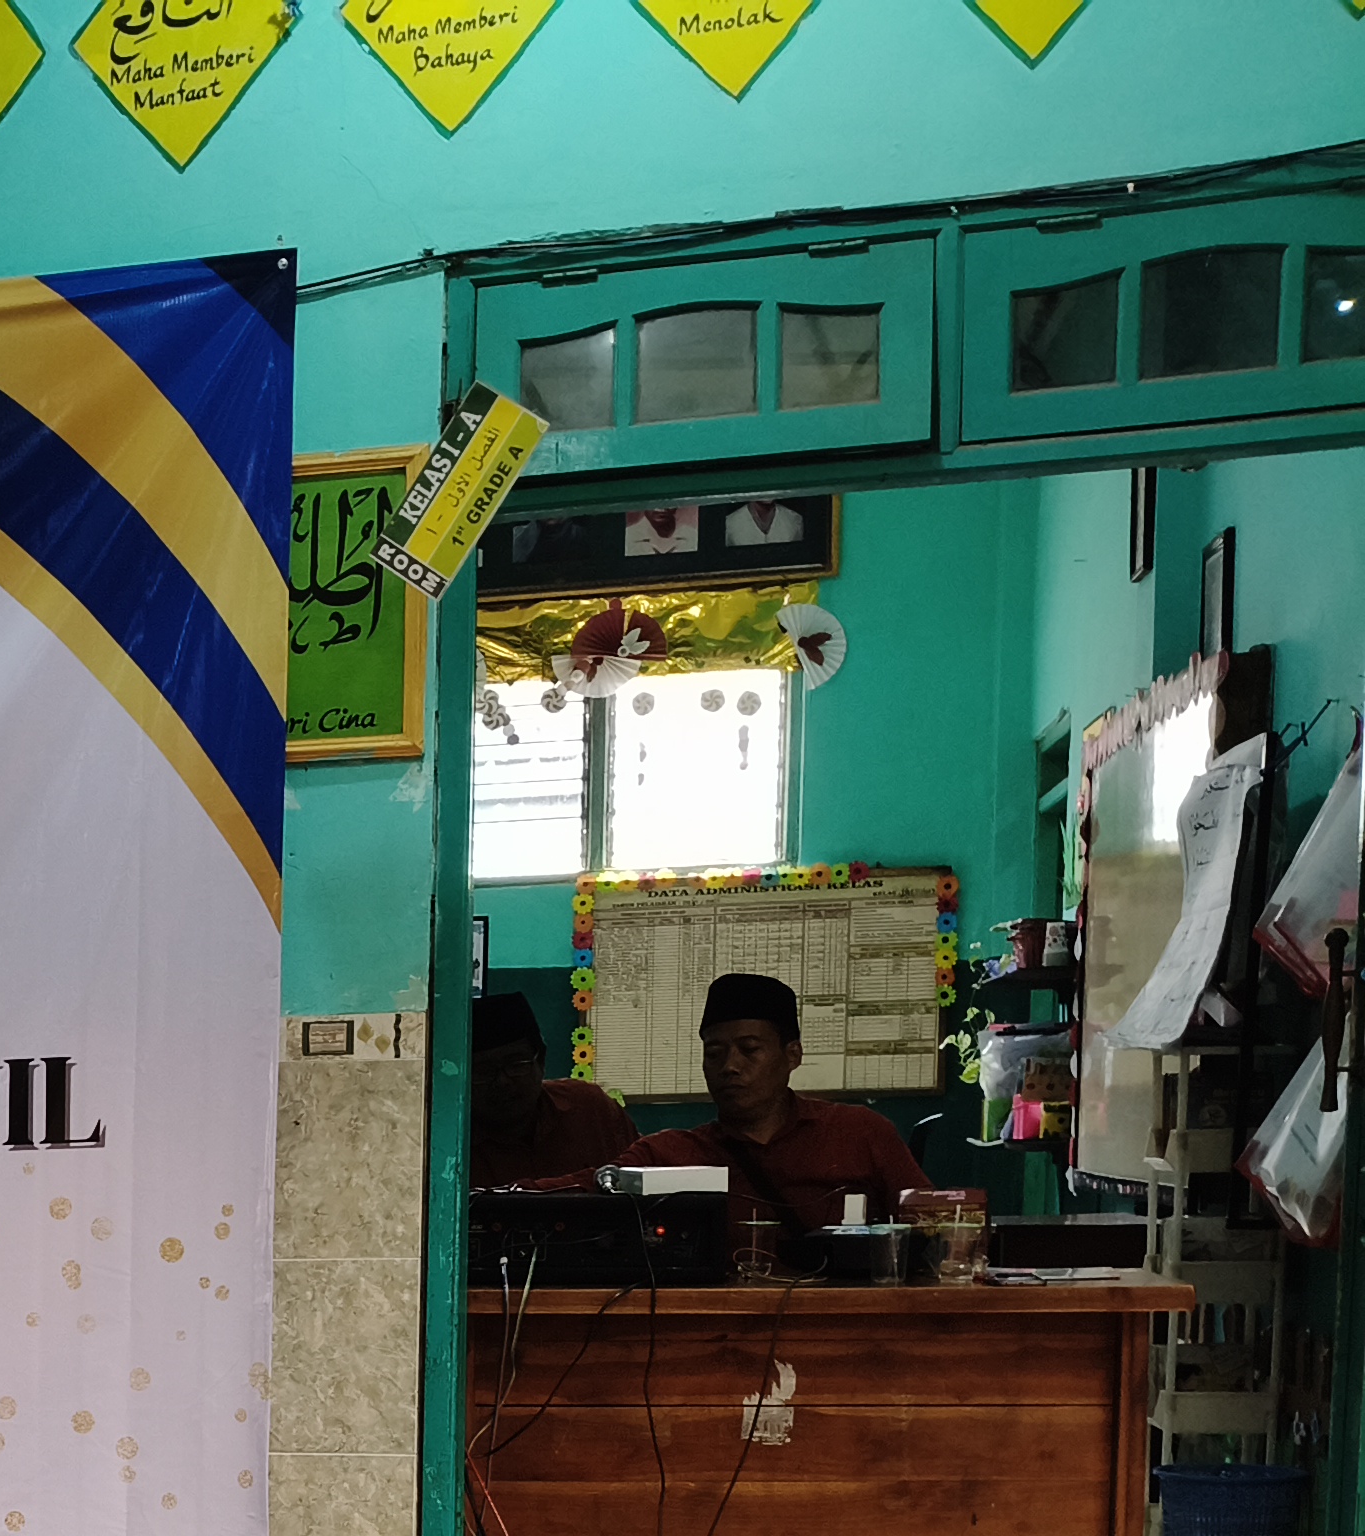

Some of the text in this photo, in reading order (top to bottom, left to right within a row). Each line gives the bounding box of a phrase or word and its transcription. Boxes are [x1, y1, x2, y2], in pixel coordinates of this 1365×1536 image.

[378, 10, 519, 47] Maha Memberi
[679, 0, 784, 36] Menolak
[110, 45, 256, 87] Maha Memberi
[413, 43, 494, 78] Bahaya
[134, 77, 224, 111] Manfaat
[399, 454, 452, 524] KELAS
[459, 411, 483, 431] A
[466, 461, 513, 524] GRADE
[508, 445, 524, 460] A
[378, 543, 440, 592] ROOM
[319, 707, 376, 733] Cina
[648, 889, 689, 898] DATA
